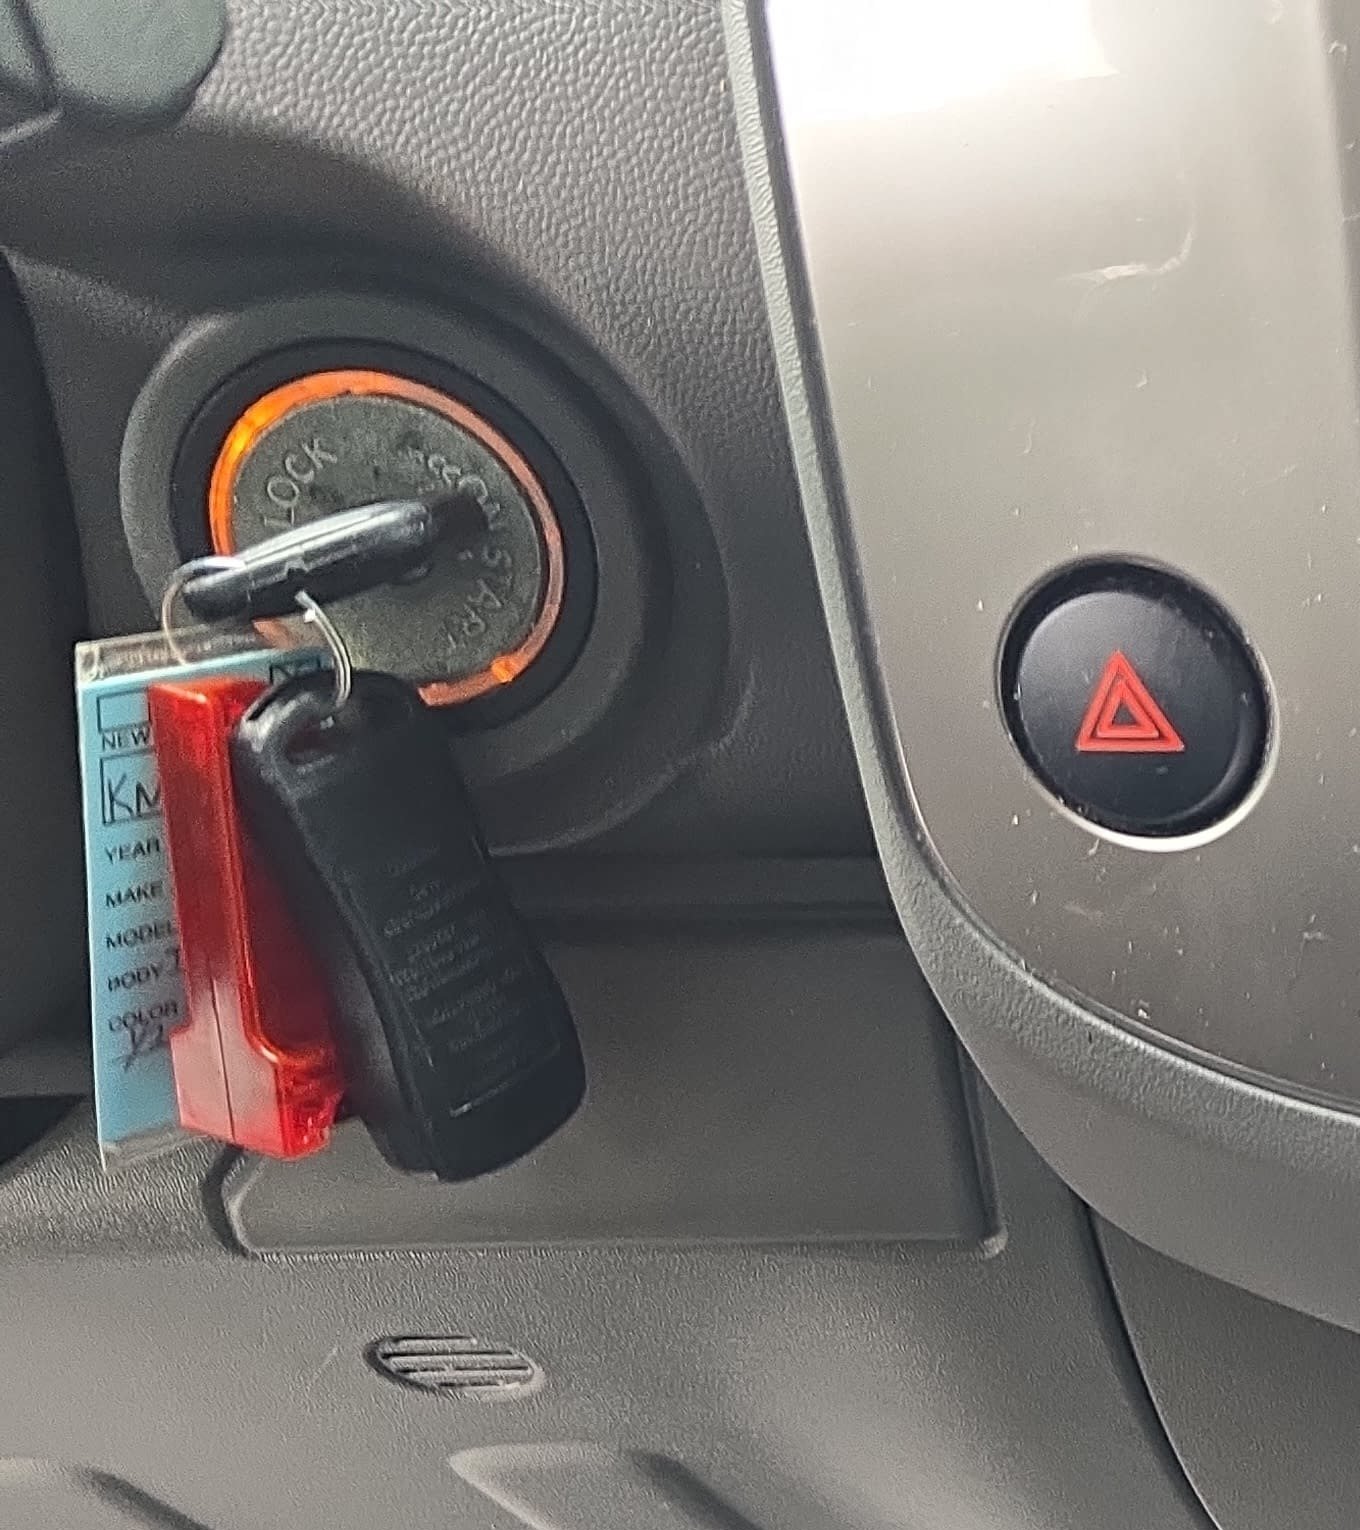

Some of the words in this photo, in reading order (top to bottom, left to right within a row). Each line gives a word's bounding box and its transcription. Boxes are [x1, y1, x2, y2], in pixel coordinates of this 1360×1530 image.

[263, 438, 339, 529] LOCK
[102, 726, 151, 752] NEW
[104, 839, 162, 864] YEAR
[104, 881, 166, 908] MAKE
[107, 964, 160, 994] BODY
[107, 1001, 178, 1031] COLOR
